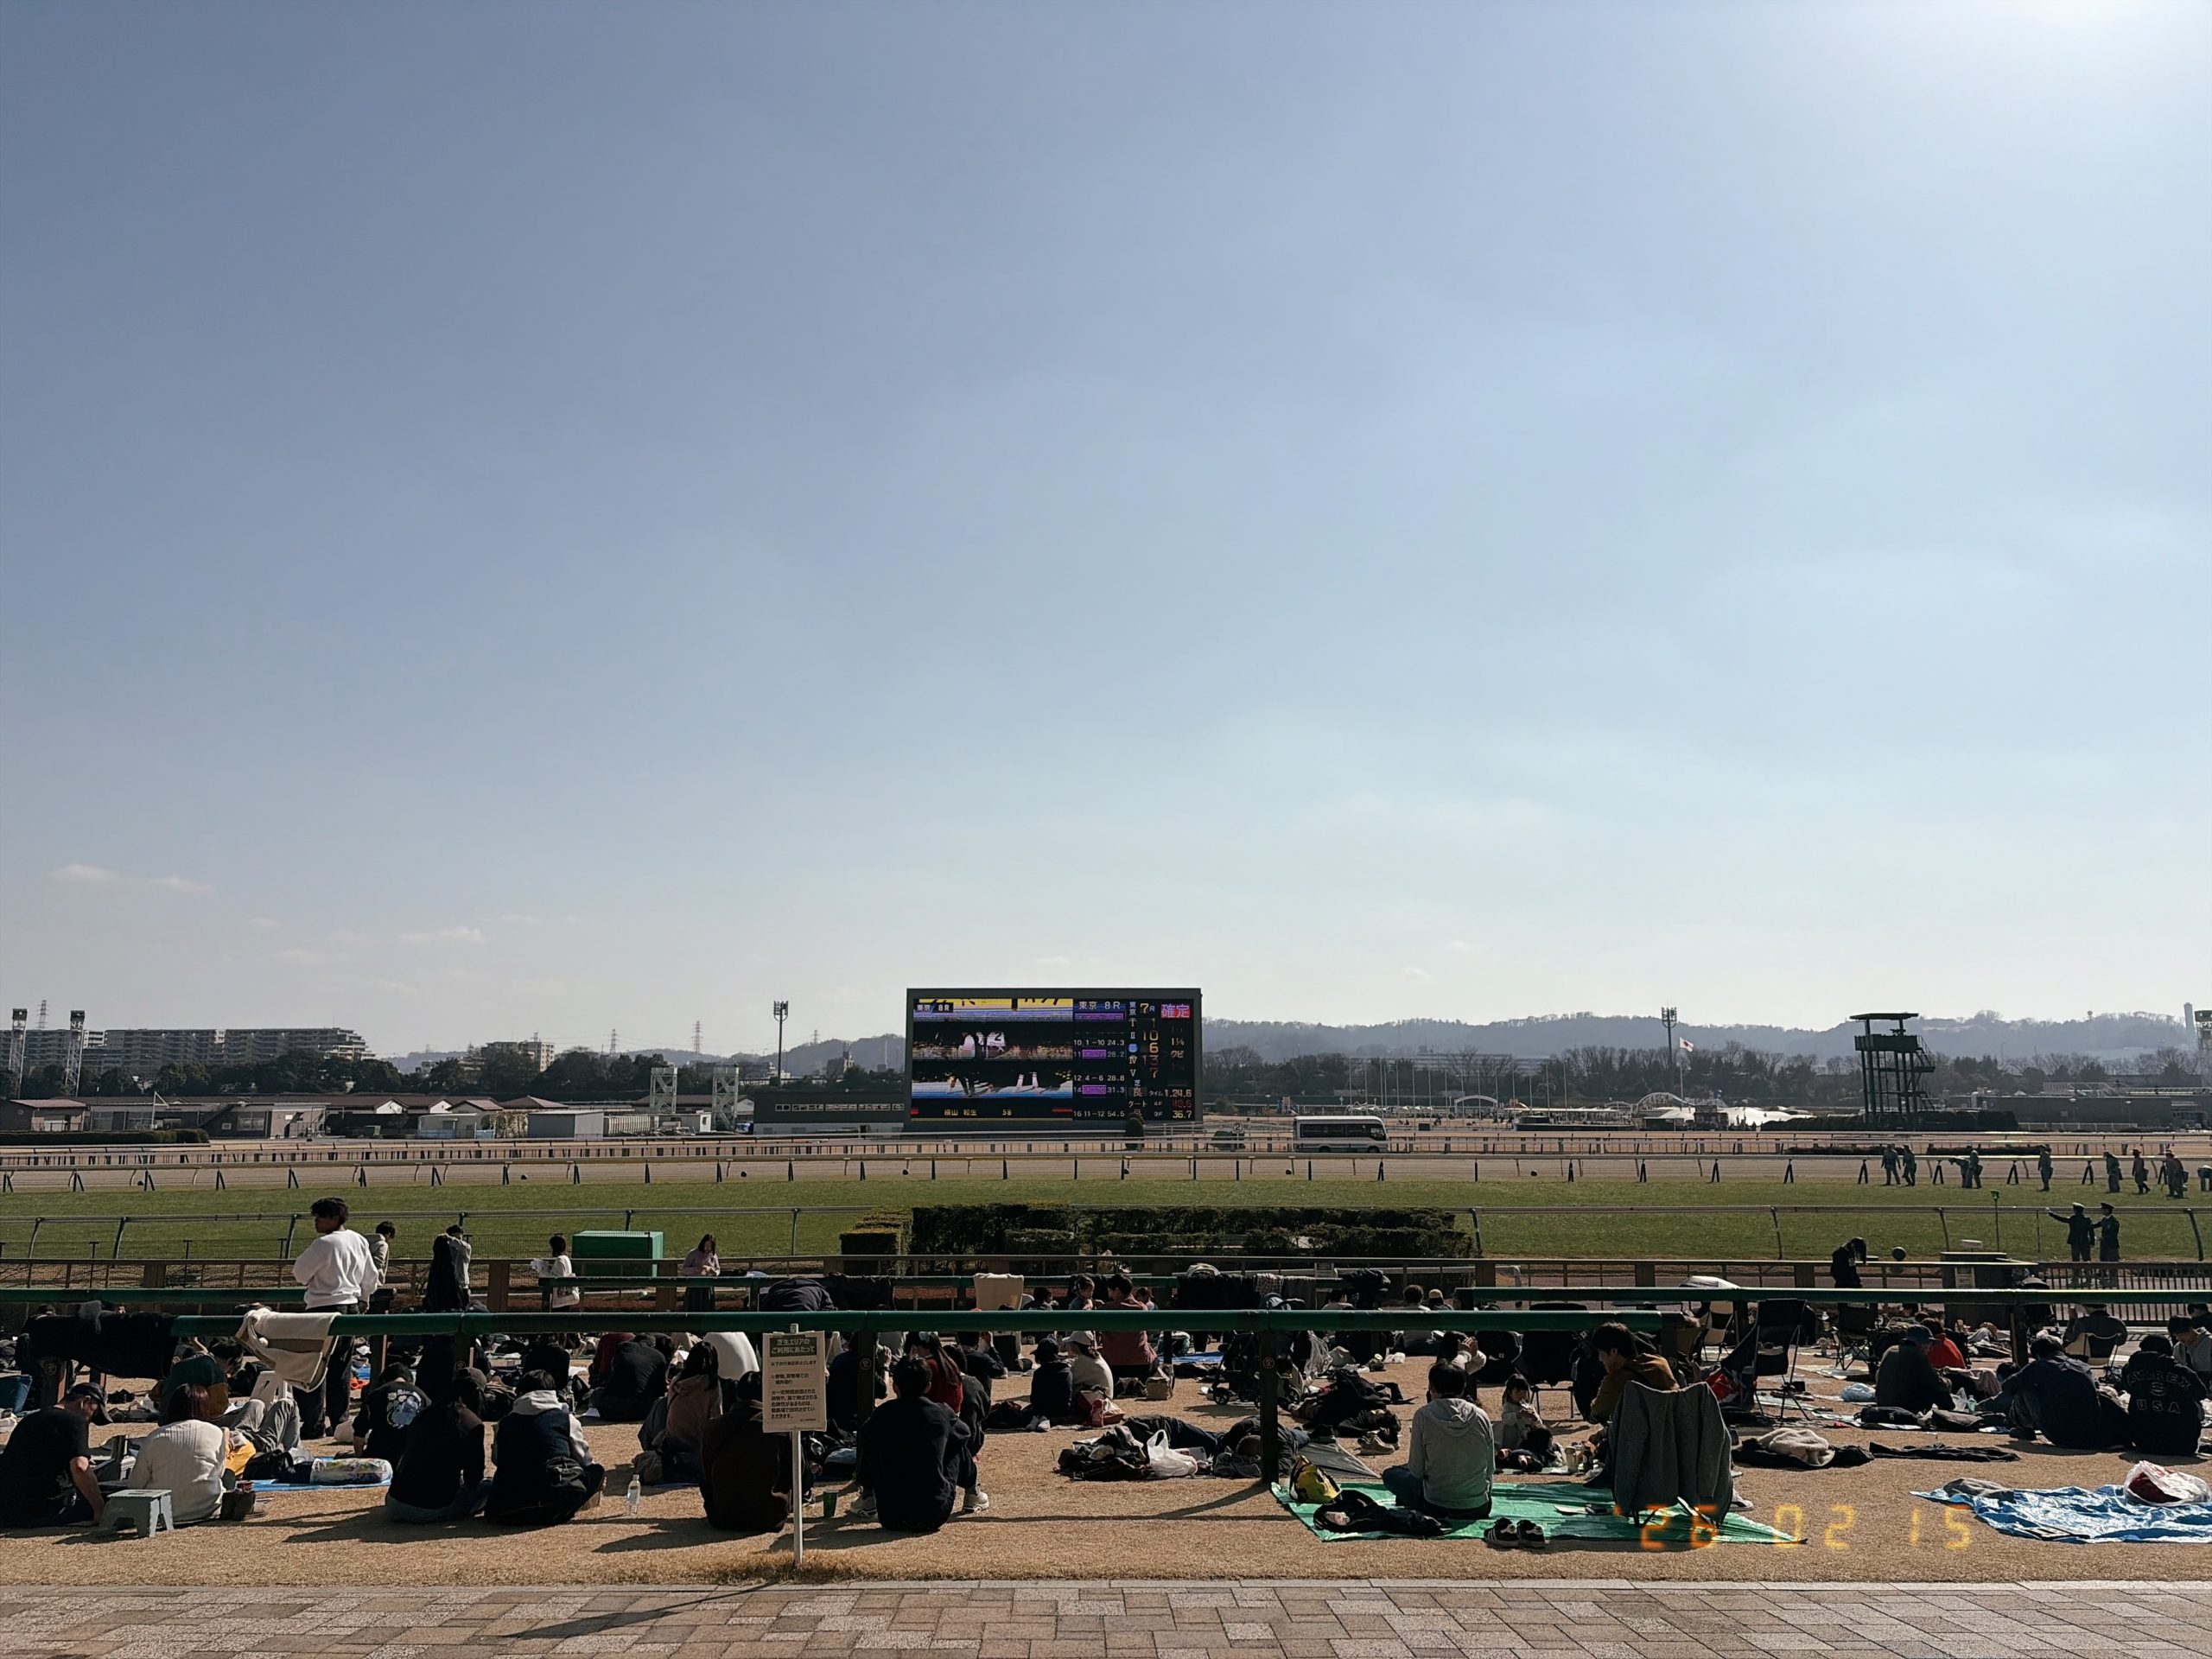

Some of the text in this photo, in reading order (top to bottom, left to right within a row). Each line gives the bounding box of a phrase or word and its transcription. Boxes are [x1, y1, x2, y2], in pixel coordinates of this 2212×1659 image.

[1078, 1001, 1097, 1010] 東京
[1129, 1001, 1137, 1016] 東京
[1160, 1003, 1191, 1019] 確定
[995, 1033, 1001, 1041] 2
[1142, 1030, 1159, 1041] 10
[1149, 1042, 1159, 1053] 6
[1171, 1050, 1185, 1058] クビ
[1164, 1089, 1192, 1097] 1.24.6
[1172, 1109, 1192, 1119] 36.7
